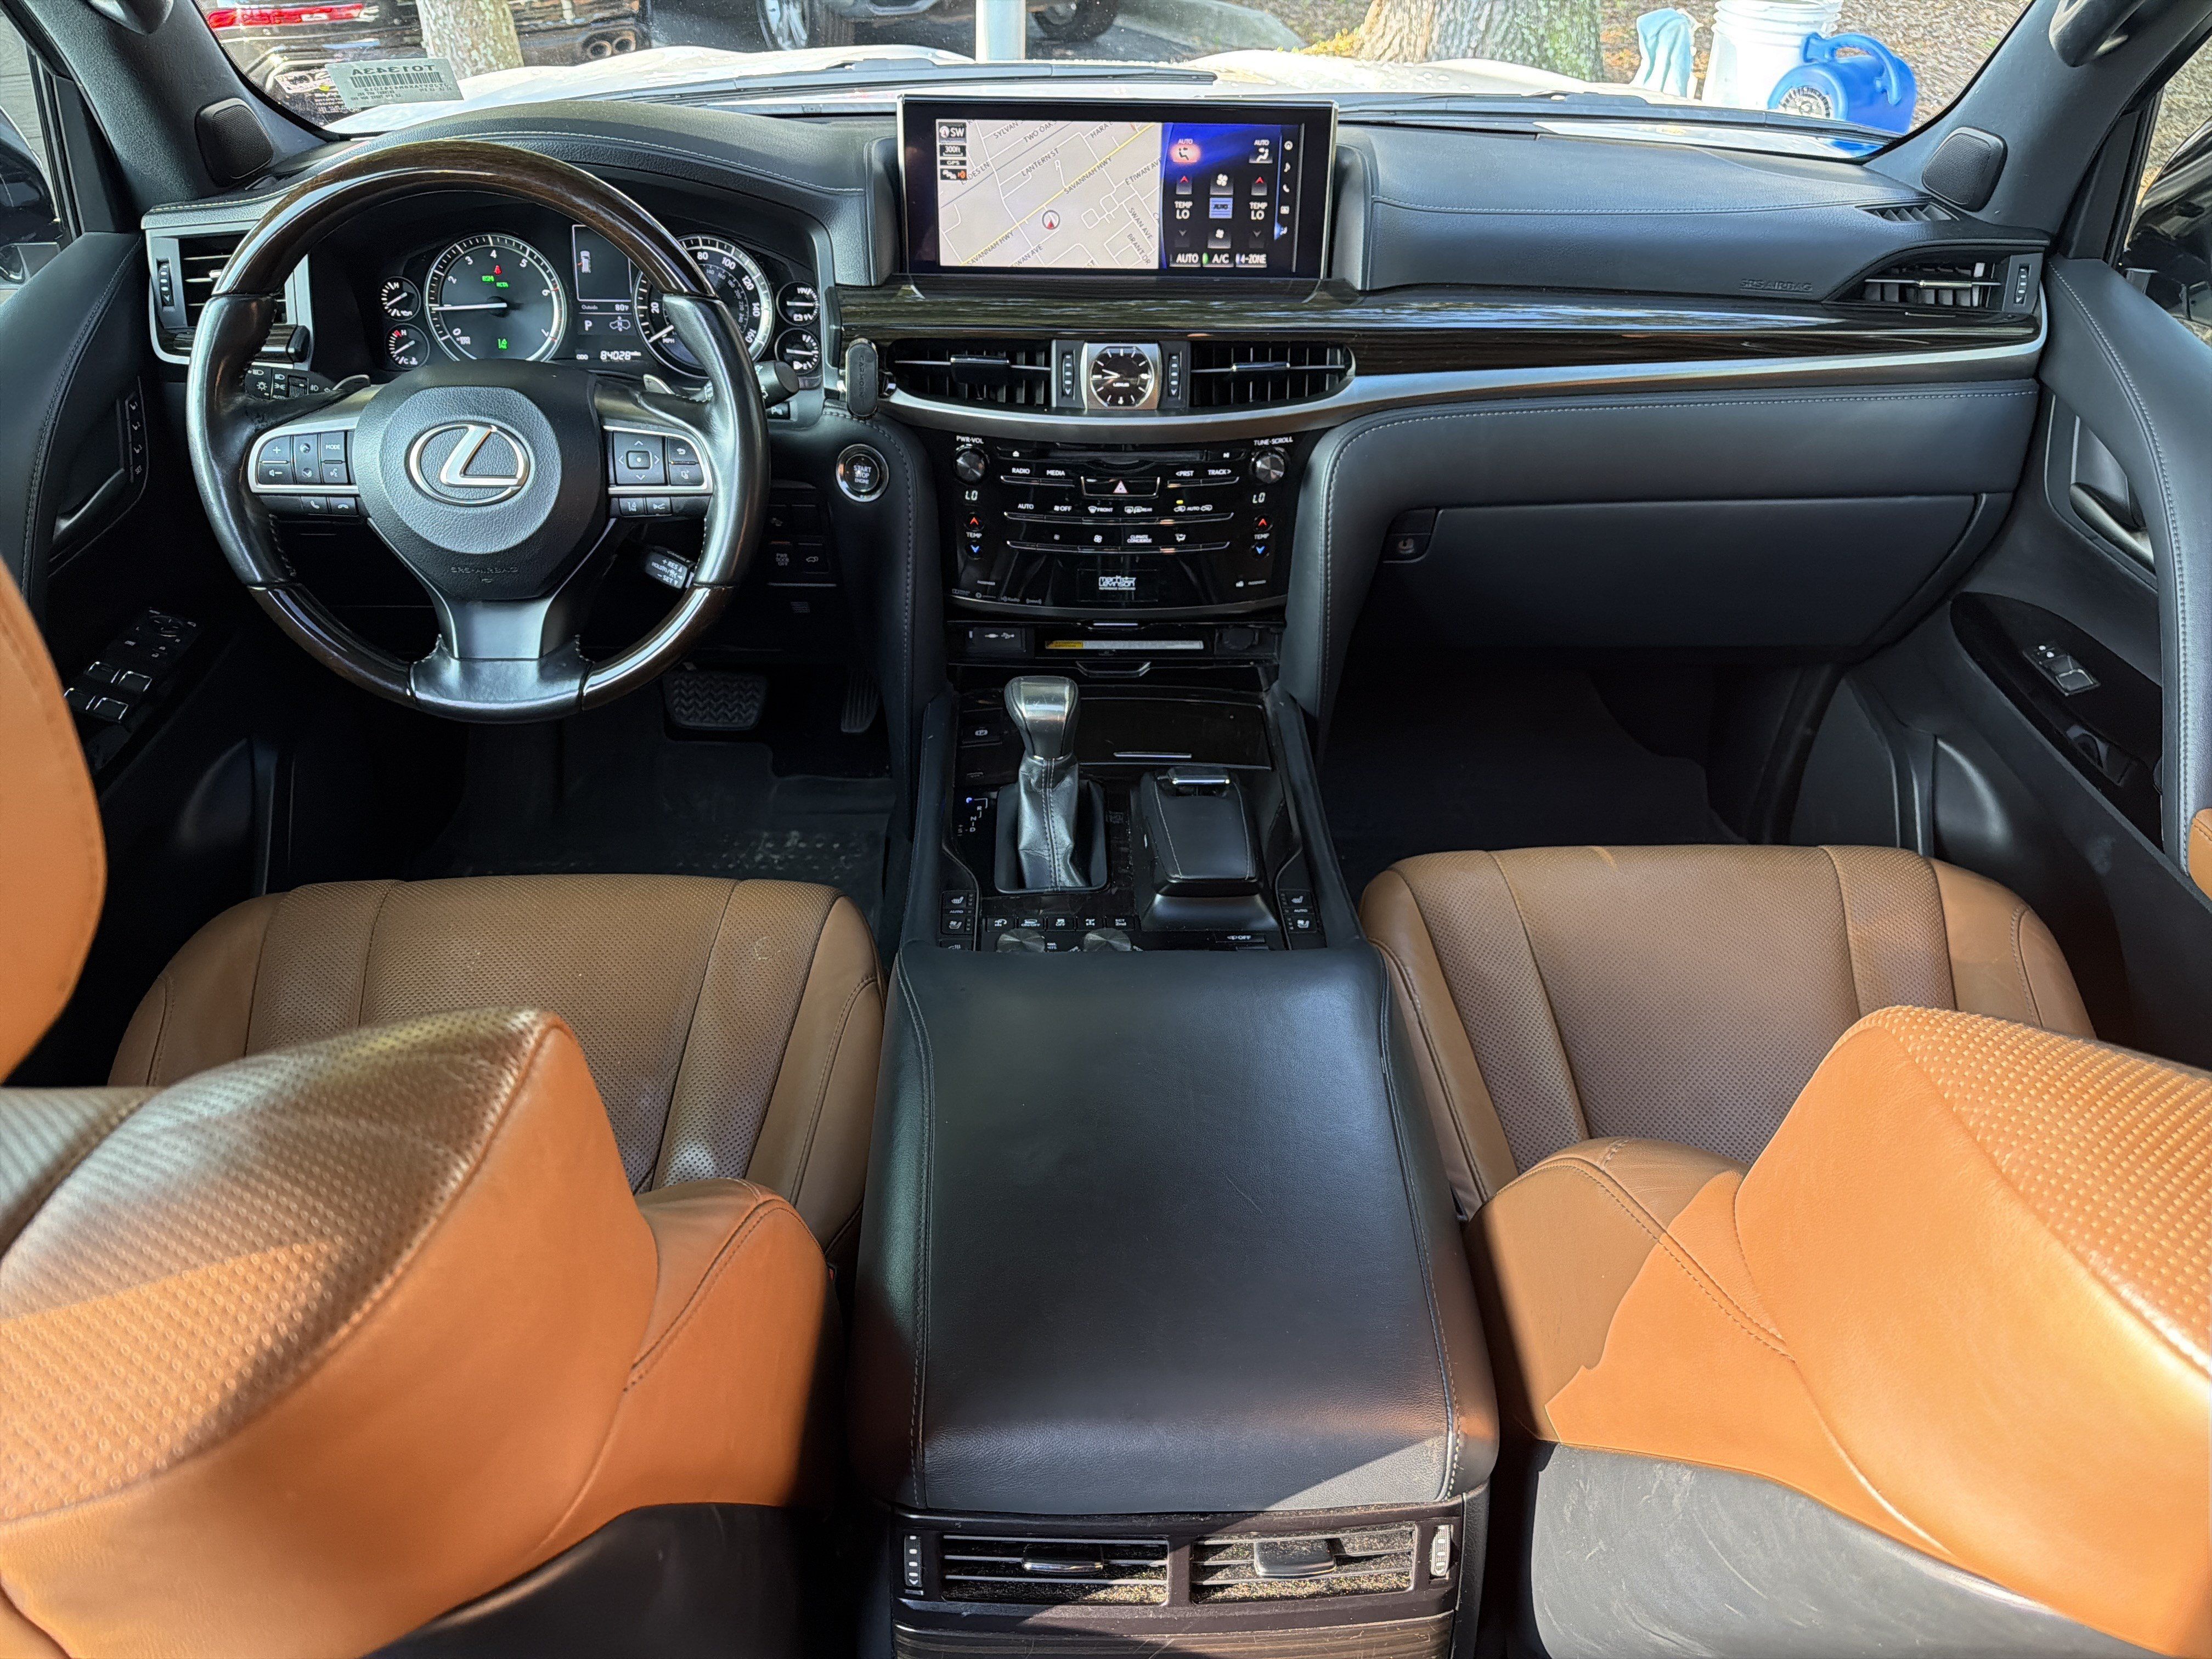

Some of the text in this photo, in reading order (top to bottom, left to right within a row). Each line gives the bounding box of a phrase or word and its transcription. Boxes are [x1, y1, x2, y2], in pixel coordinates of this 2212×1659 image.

[950, 127, 964, 137] SW
[993, 122, 1018, 139] SYLVAN
[1023, 130, 1039, 143] TWO
[1021, 148, 1059, 177] LANTERN ST
[1064, 156, 1113, 194] SAVANNAH HWY
[1125, 166, 1150, 185] ETIWAN
[1176, 209, 1190, 219] LO
[1251, 210, 1265, 220] LO
[1129, 207, 1153, 240] SWAN AVE
[999, 231, 1014, 245] HWY
[490, 250, 496, 258] 4
[1031, 244, 1043, 256] AVE
[1127, 233, 1151, 265] BRANT DR
[465, 256, 473, 265] 3
[697, 252, 709, 261] 80
[1176, 253, 1199, 263] AUTO
[1212, 253, 1229, 263] A/C
[1240, 253, 1267, 264] 4-ZONE
[520, 258, 528, 268] 5
[721, 257, 736, 269] 100
[448, 275, 457, 284] 2
[742, 275, 754, 291] 120
[1740, 279, 1813, 291] SRS AIRBAG
[650, 302, 660, 314] 20
[752, 302, 760, 317] 140
[584, 320, 592, 331] P
[541, 329, 549, 337] 7
[745, 328, 757, 343] 160
[600, 350, 631, 360] 84028
[965, 490, 978, 501] LO
[1252, 493, 1266, 504] LO
[667, 561, 679, 570] RES
[663, 574, 674, 584] SET
